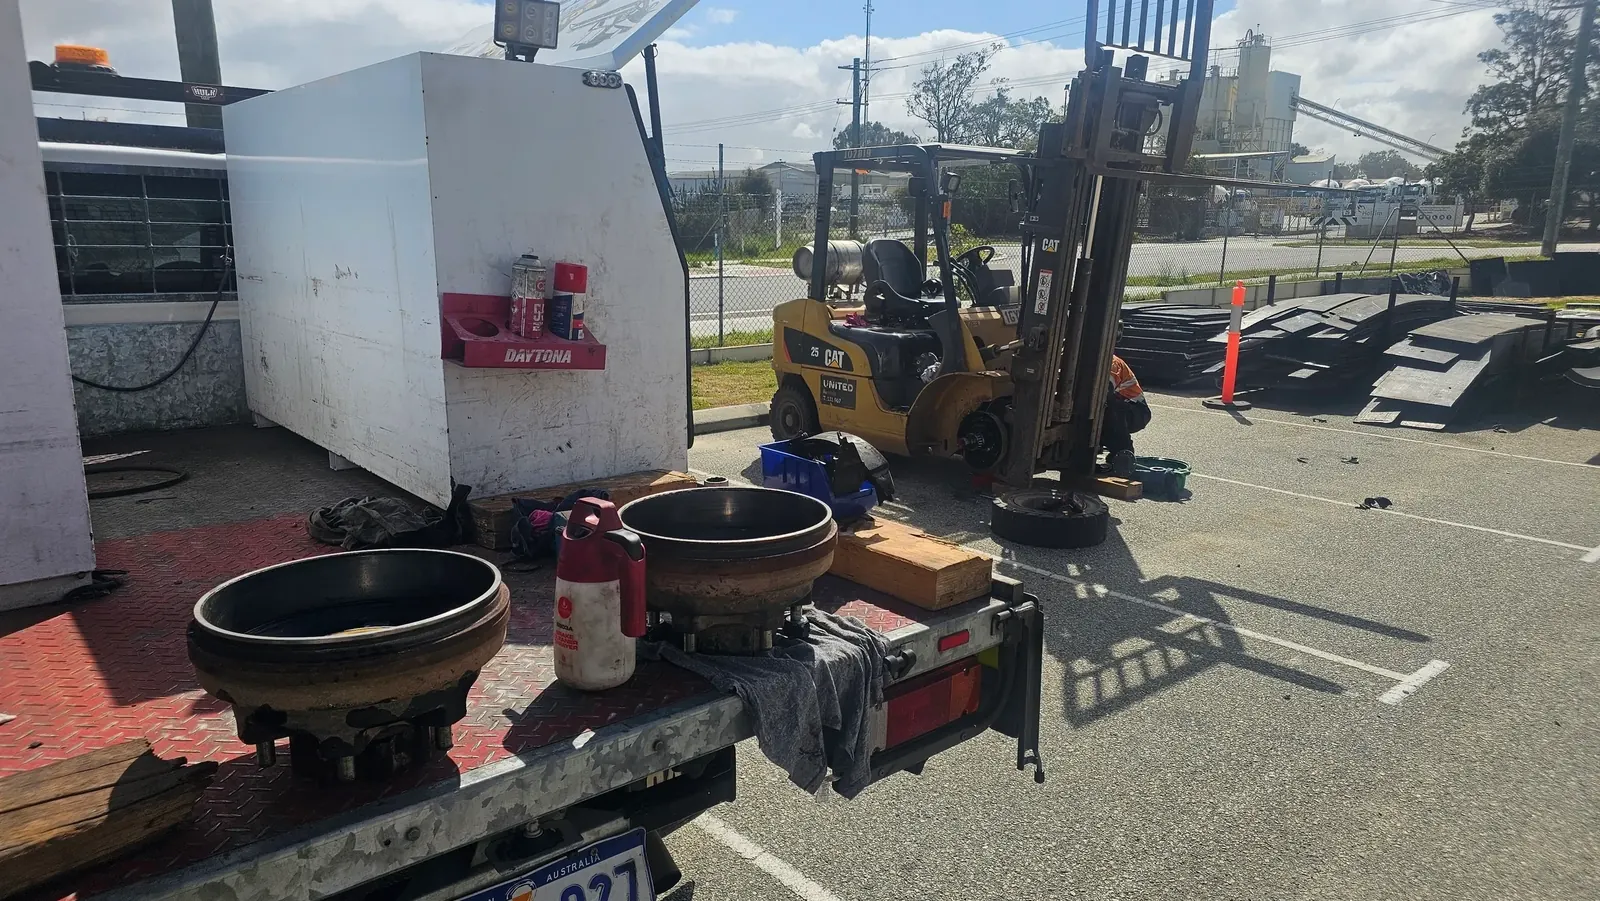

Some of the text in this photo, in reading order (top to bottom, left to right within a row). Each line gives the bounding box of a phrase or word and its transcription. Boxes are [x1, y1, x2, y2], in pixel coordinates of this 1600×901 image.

[193, 88, 216, 96] HULK
[1042, 238, 1060, 253] CAT
[504, 348, 571, 363] DAYTONA
[810, 346, 845, 369] 25 CAT
[823, 379, 854, 392] UNITED
[546, 853, 601, 882] AUSTRALIA
